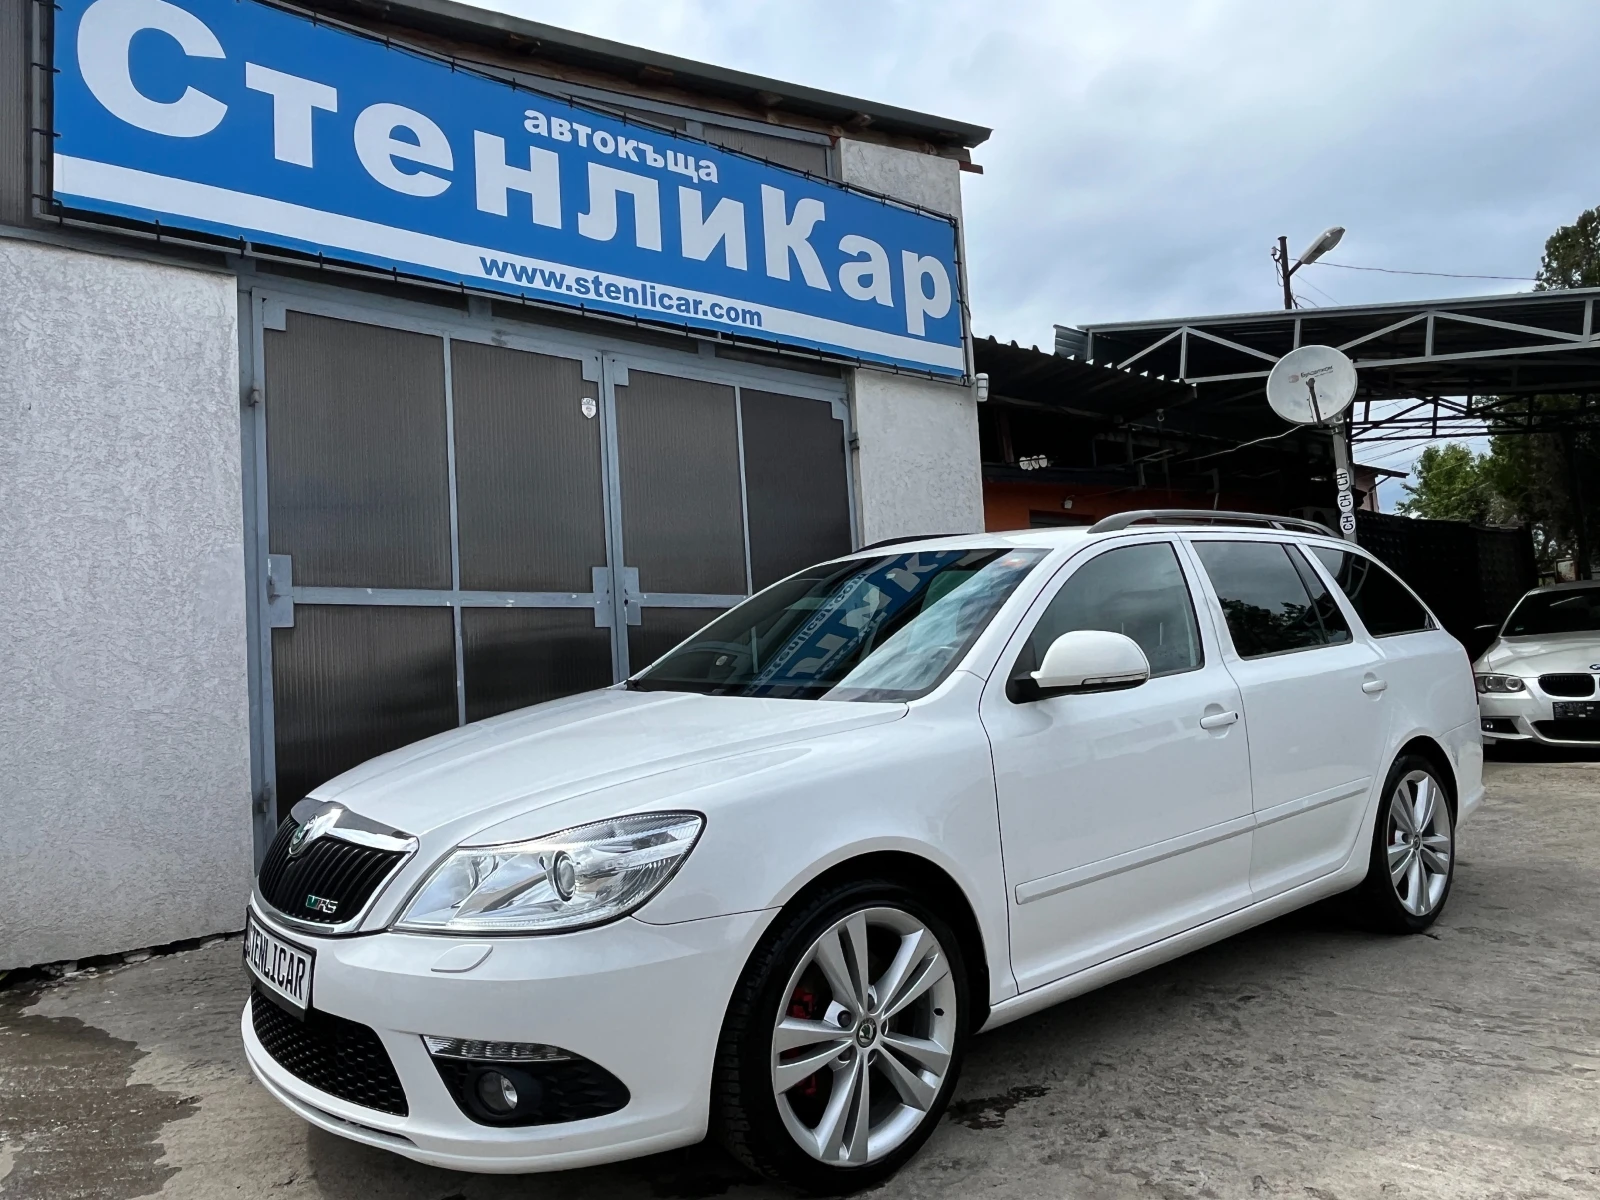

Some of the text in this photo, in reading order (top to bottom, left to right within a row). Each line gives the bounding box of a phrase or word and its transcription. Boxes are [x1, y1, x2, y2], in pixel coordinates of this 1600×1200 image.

[77, 0, 952, 337] СтенлиКар
[523, 109, 719, 184] автокъща
[479, 256, 762, 328] www.stenlicar.com
[1336, 472, 1348, 486] CH
[1339, 494, 1351, 507] CH
[1342, 516, 1354, 531] CH
[246, 922, 306, 1001] TENLICAR
